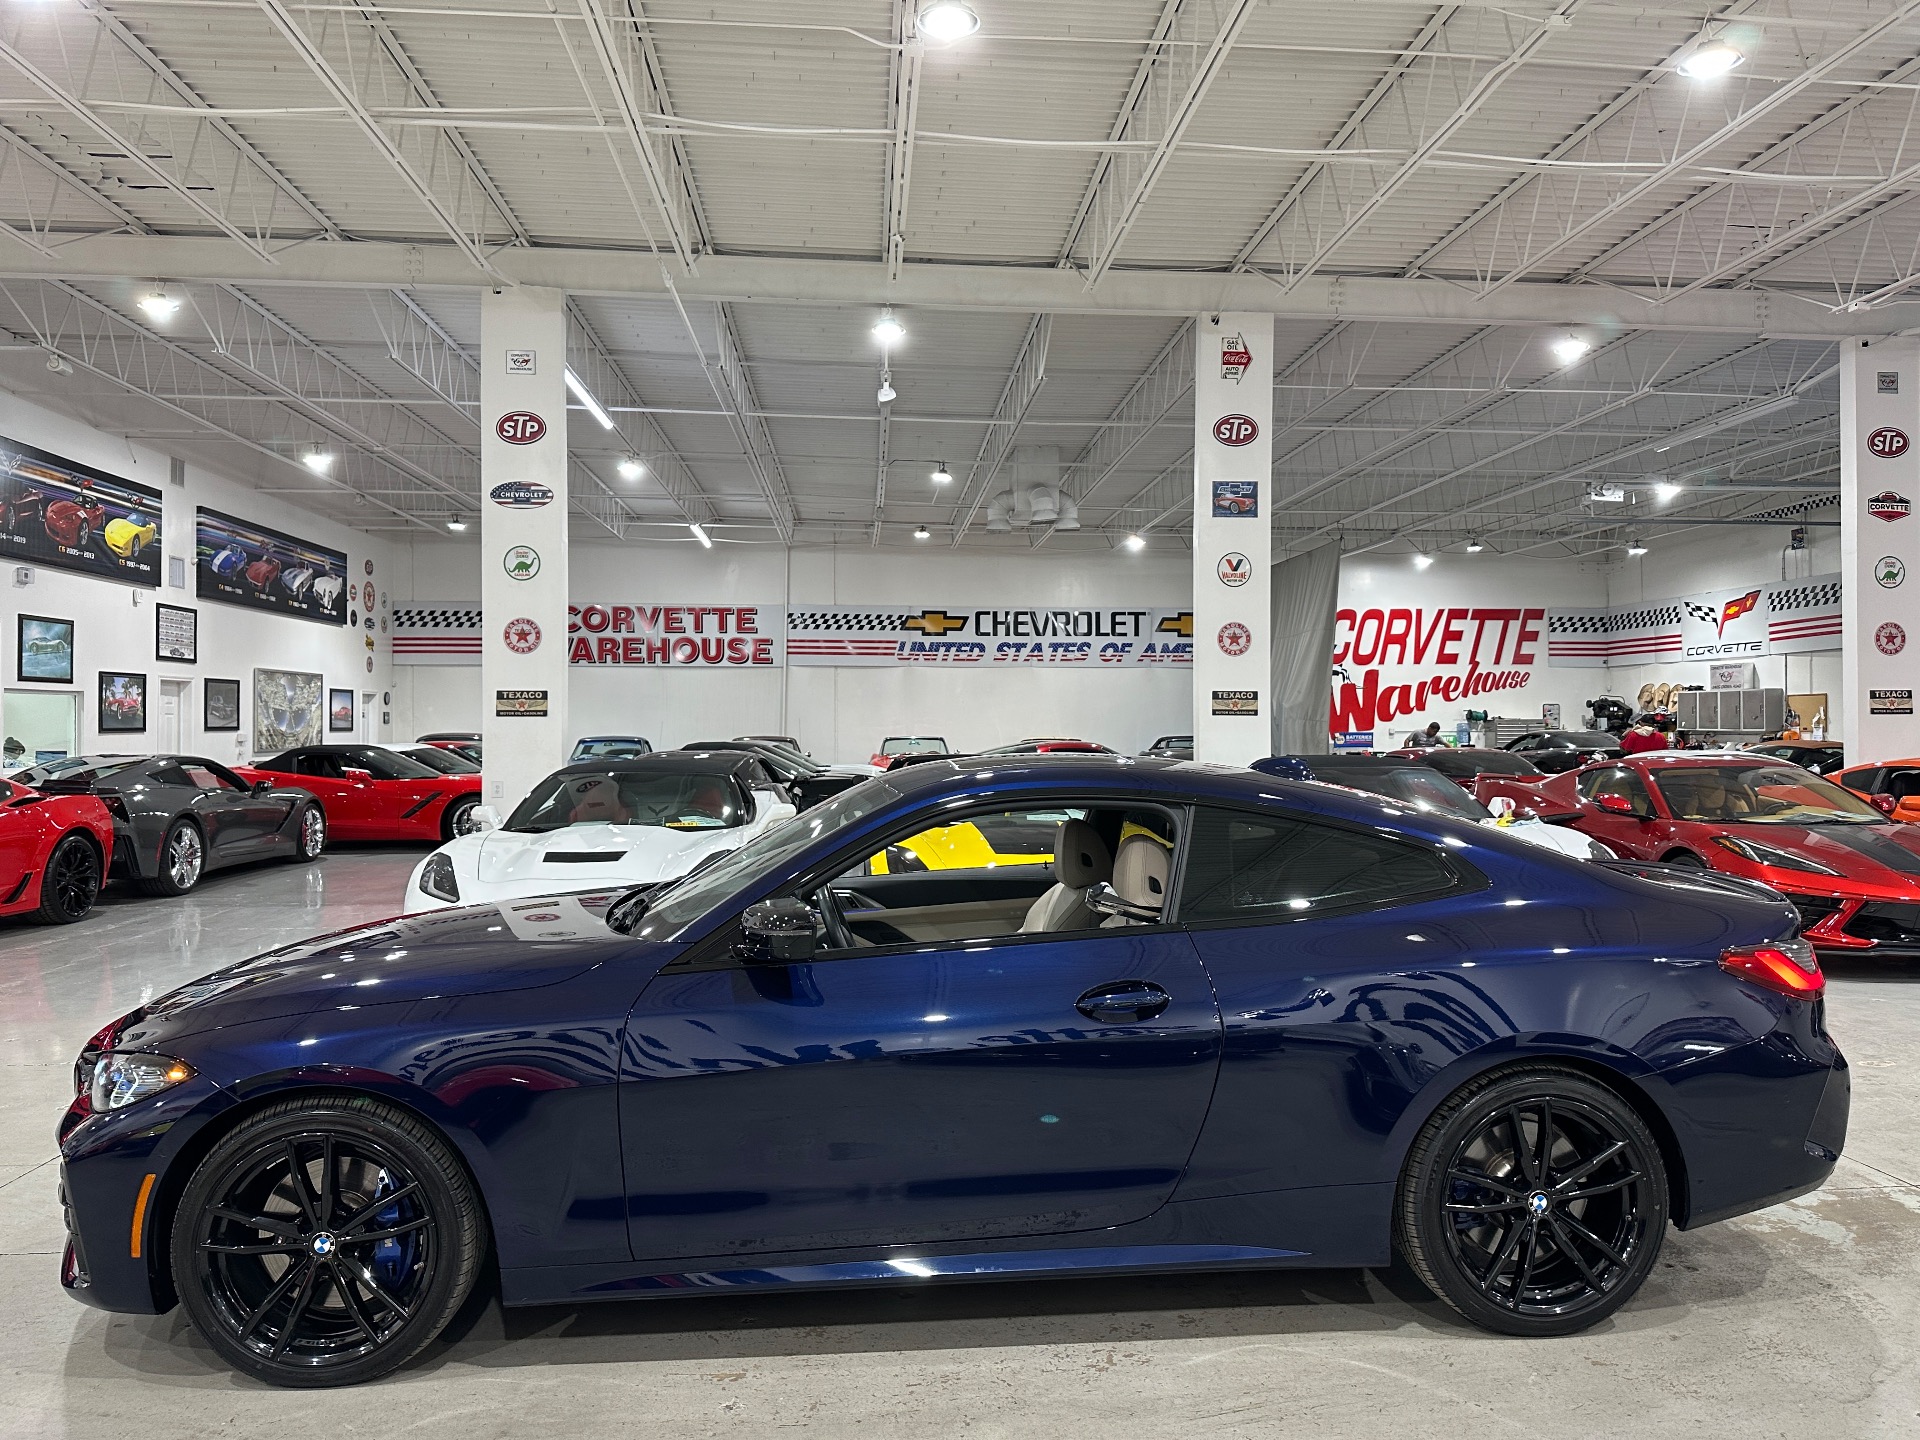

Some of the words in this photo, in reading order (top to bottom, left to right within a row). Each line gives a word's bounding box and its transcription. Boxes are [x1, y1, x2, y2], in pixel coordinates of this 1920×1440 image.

[502, 415, 539, 439] STP
[1219, 418, 1252, 441] STP
[1873, 431, 1904, 452] STP
[1870, 503, 1909, 511] CORVETTE
[1222, 571, 1246, 579] VALVOLINE
[506, 618, 539, 632] GASOLINE
[568, 604, 758, 633] CORVETTE
[974, 610, 1148, 637] CHEVROLET
[1219, 623, 1249, 635] GASOLINE
[506, 638, 529, 653] MOTOR
[1333, 608, 1545, 665] CORVETTE
[568, 636, 773, 664] AREHOUSE
[896, 641, 986, 662] UNITED
[993, 641, 1091, 662] STATES
[1099, 641, 1134, 662] OF
[1137, 642, 1193, 662] AME
[1687, 640, 1763, 657] CORVETTE
[502, 691, 543, 699] TEXACO
[1217, 691, 1253, 699] TEXACO
[1329, 660, 1531, 740] Warehouse
